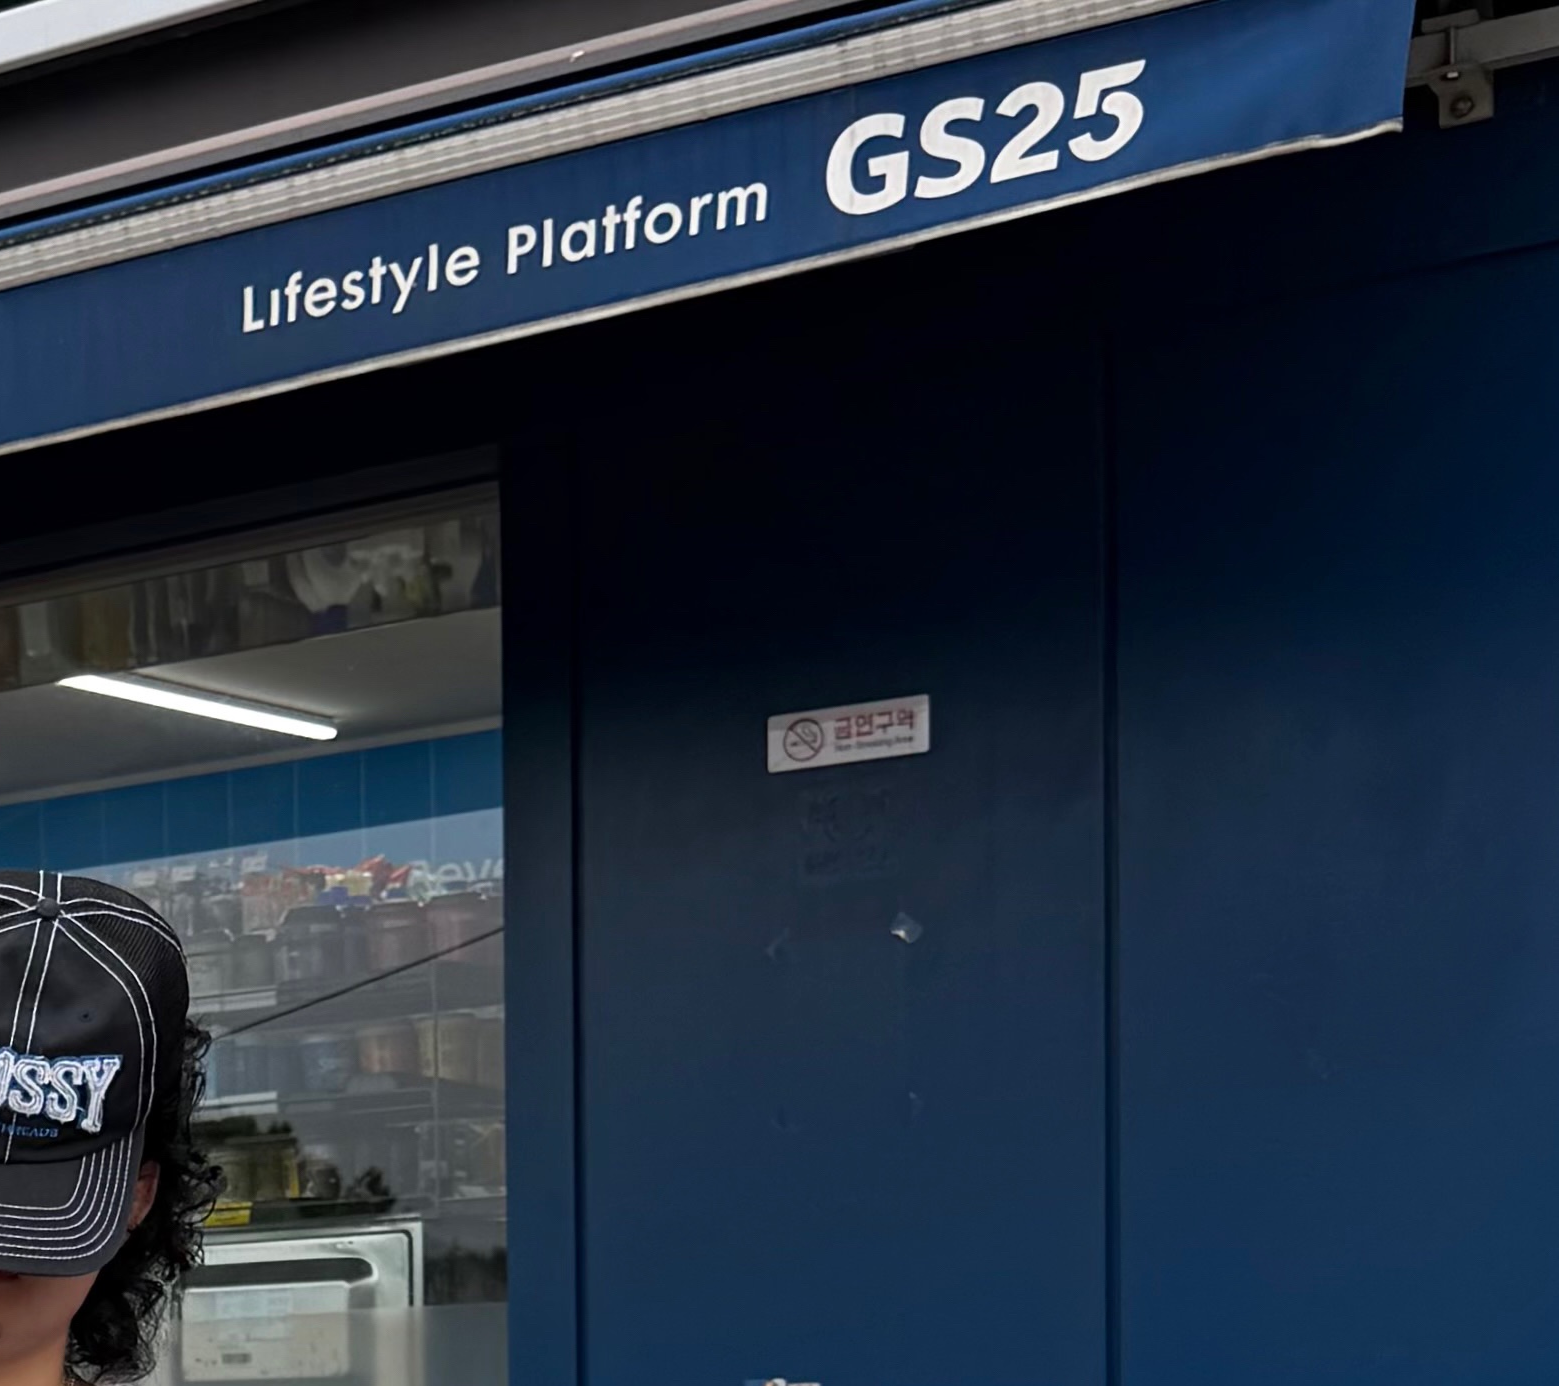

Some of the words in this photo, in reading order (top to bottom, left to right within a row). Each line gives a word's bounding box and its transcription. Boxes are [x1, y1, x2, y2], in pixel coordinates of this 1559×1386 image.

[241, 242, 481, 334] Lifestyle
[505, 178, 769, 277] Platform
[823, 58, 1147, 217] GS25
[834, 709, 916, 740] 금연구역
